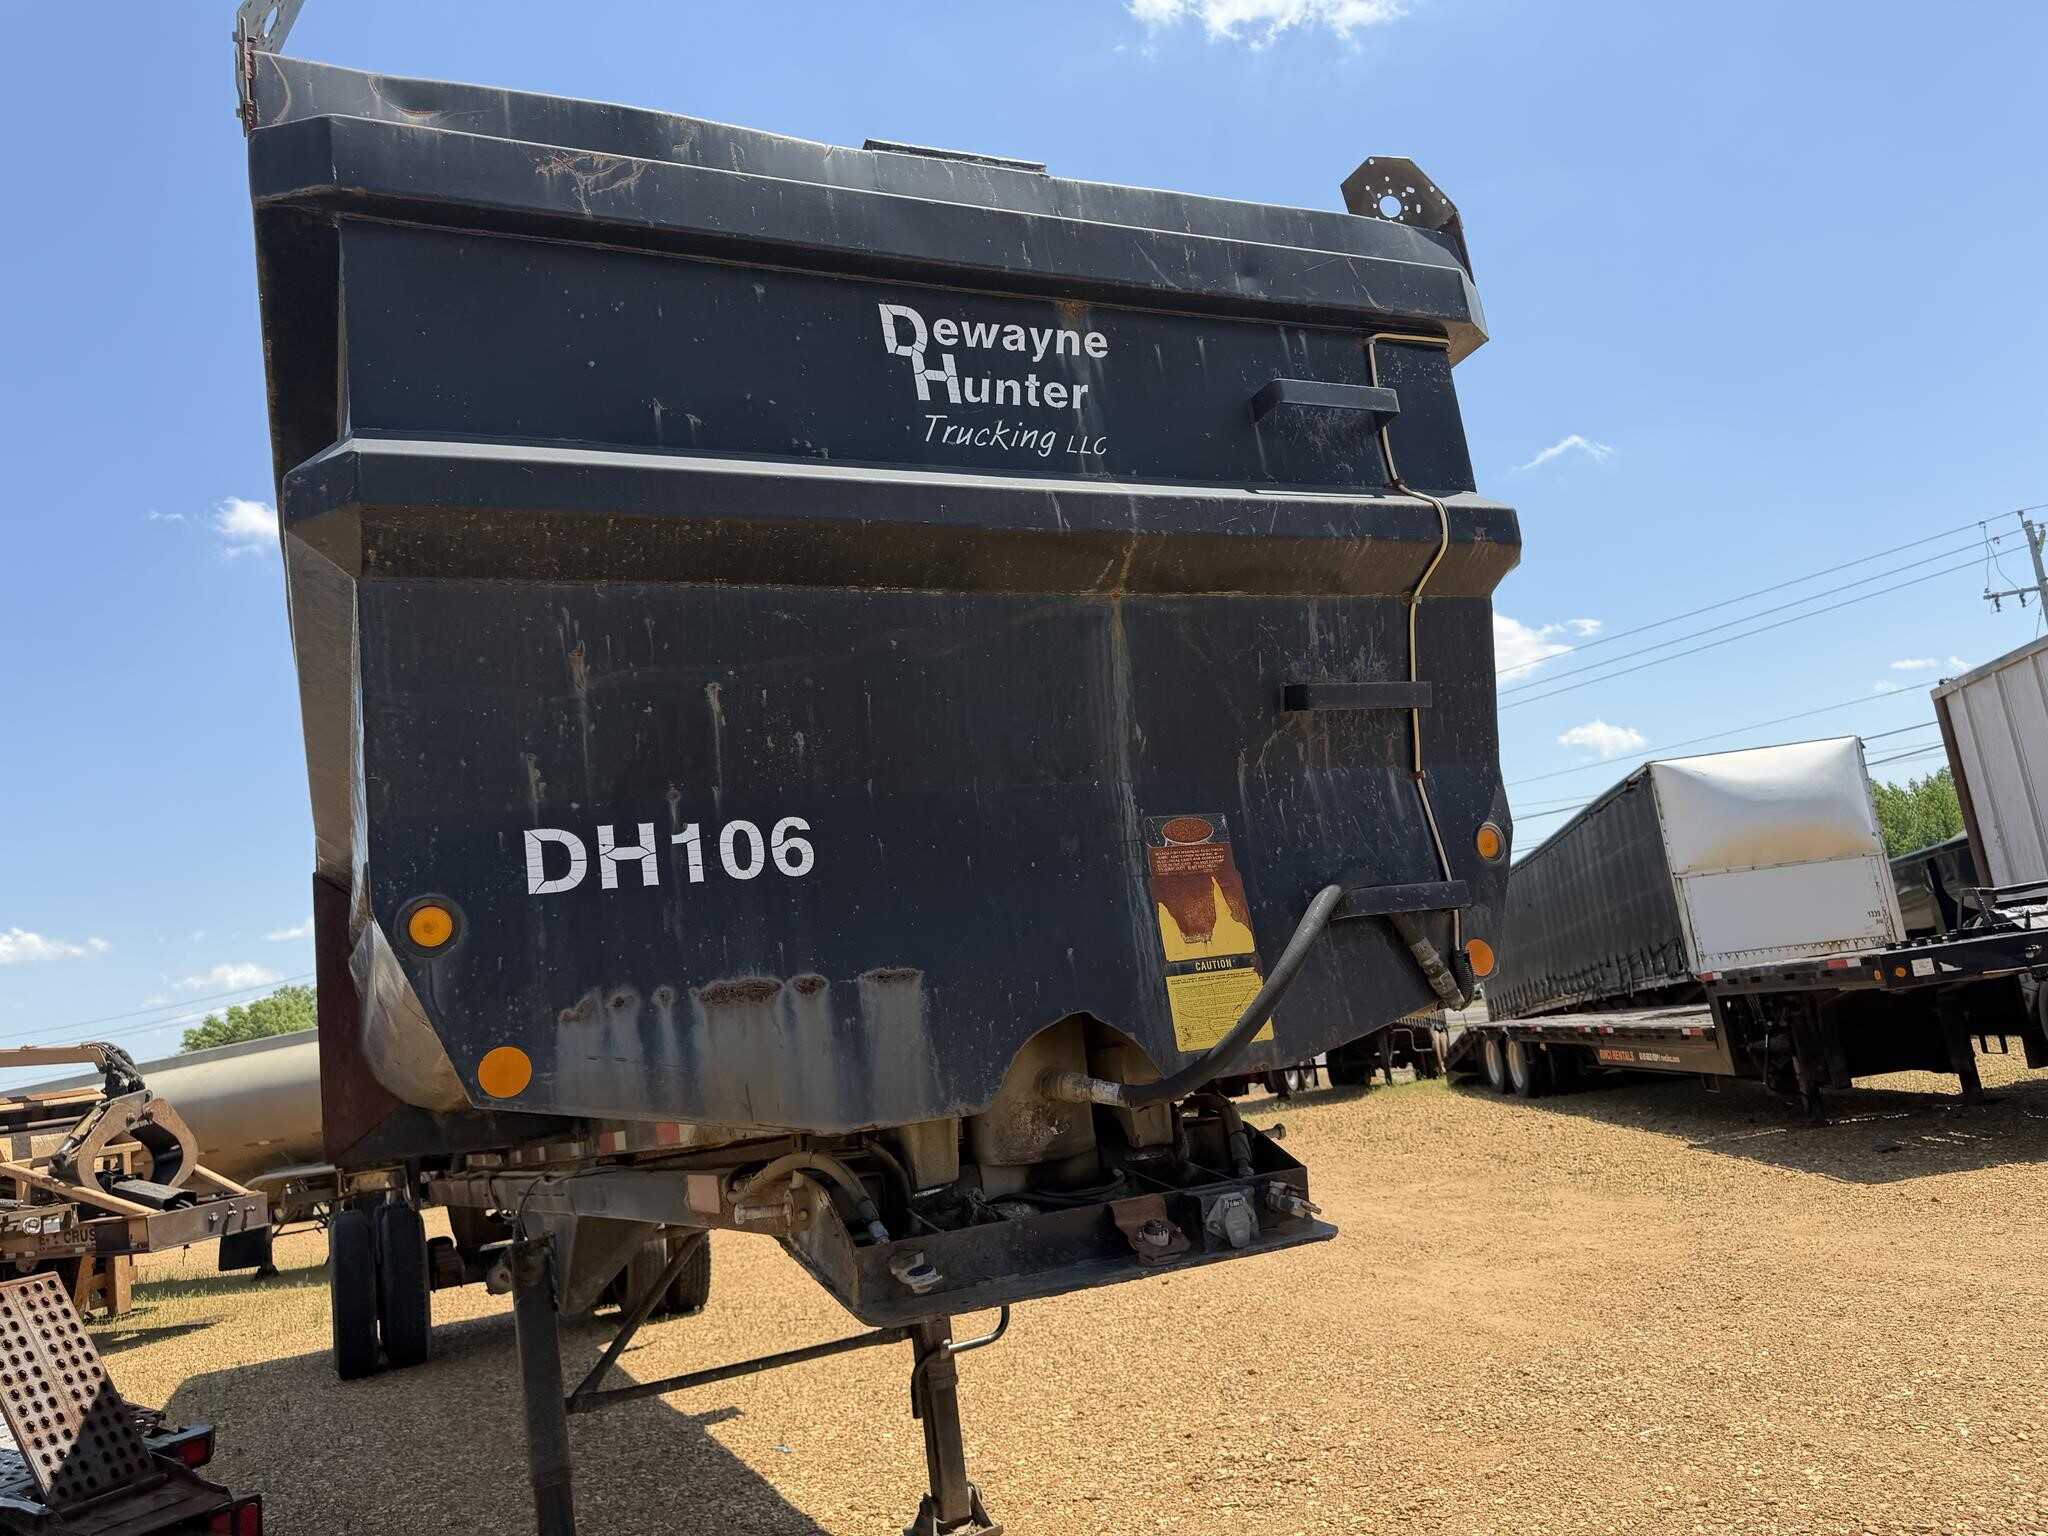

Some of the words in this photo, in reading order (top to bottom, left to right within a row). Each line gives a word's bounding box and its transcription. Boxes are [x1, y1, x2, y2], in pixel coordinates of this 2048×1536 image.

[878, 303, 1109, 363] Dewayne
[911, 348, 1089, 409] Hunter
[924, 414, 1057, 458] Trucking
[1065, 435, 1108, 455] LLC
[524, 816, 815, 895] DH106
[1195, 958, 1233, 971] CAUTION
